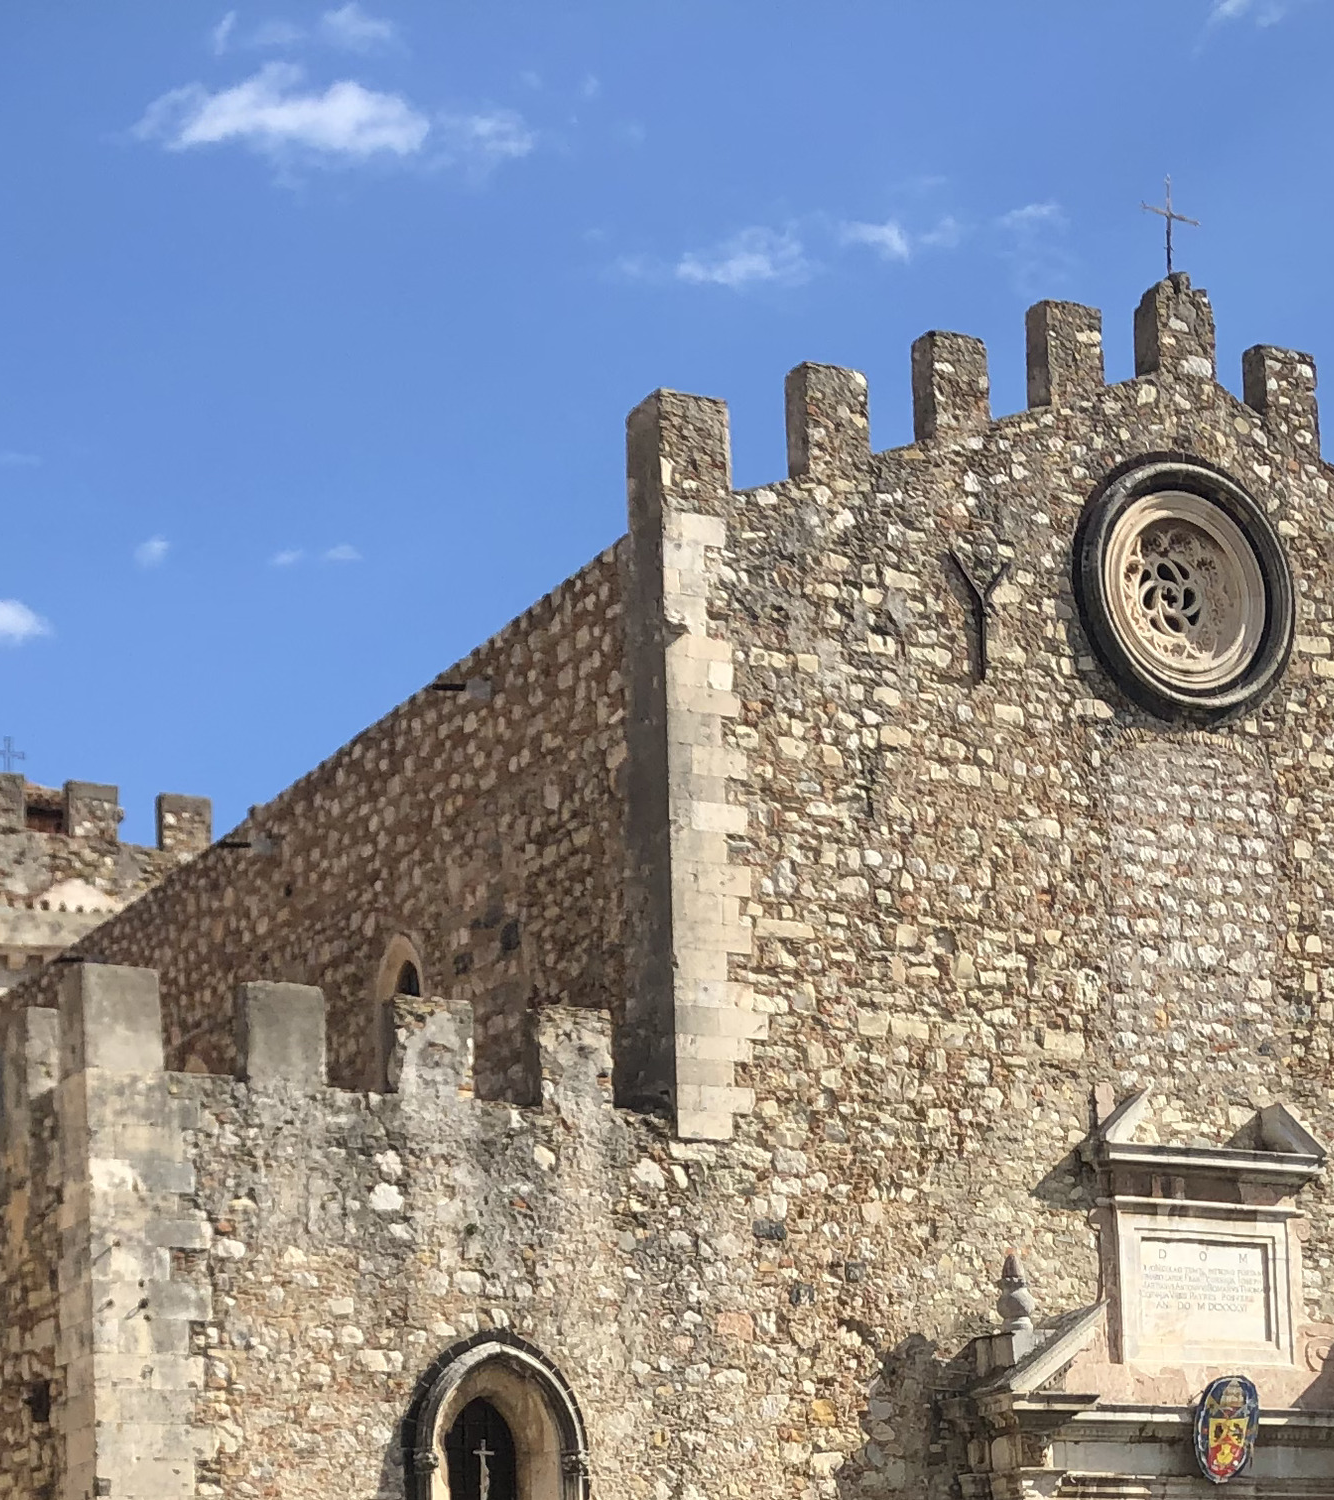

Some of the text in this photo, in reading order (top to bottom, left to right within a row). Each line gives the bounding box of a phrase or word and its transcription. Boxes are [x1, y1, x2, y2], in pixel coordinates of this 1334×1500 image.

[1158, 1248, 1248, 1264] D O M
